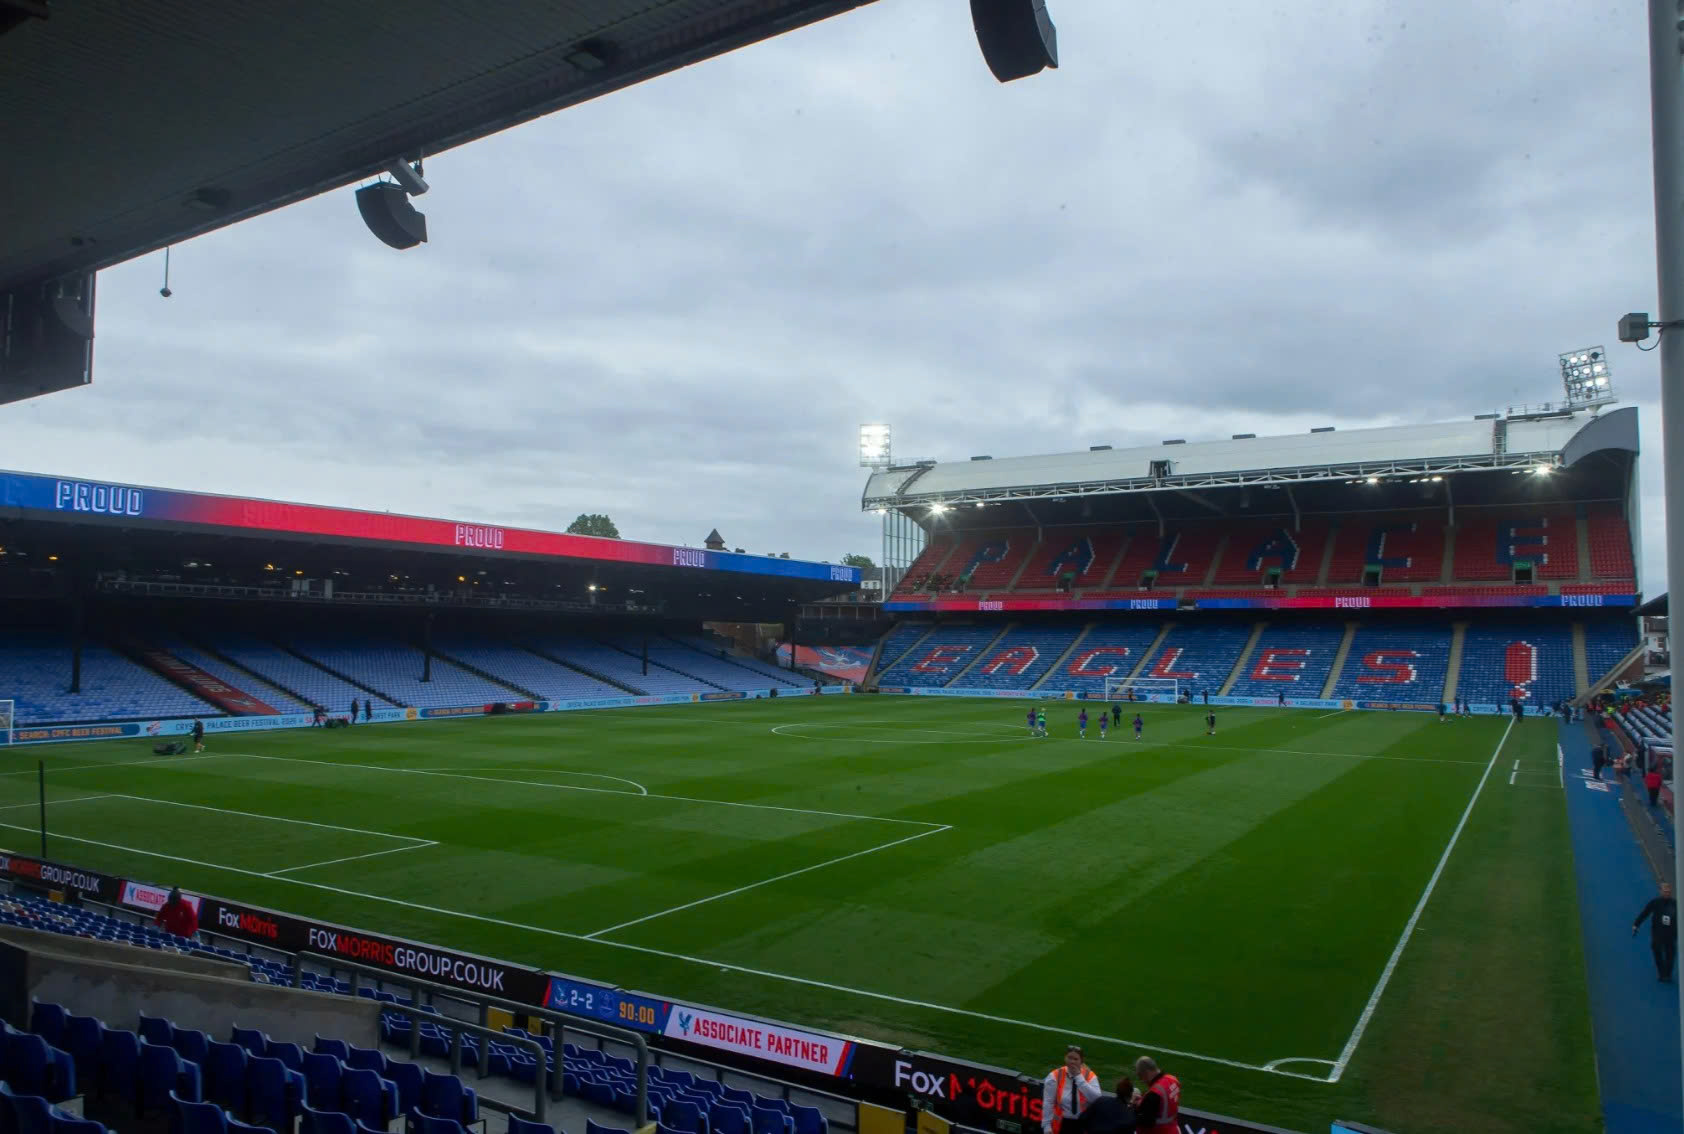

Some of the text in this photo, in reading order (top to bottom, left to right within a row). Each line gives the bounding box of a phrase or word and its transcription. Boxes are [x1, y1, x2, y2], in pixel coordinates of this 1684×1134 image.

[56, 480, 143, 516] PROUD
[455, 524, 505, 550] PROUD
[673, 547, 705, 568] PROUD
[830, 565, 853, 582] PROUD
[979, 600, 1003, 611] PROUD
[1130, 599, 1158, 610] PROUD
[1335, 595, 1370, 608] PROUD
[1561, 594, 1602, 607] PROUD
[206, 720, 232, 729] PALACE
[233, 719, 250, 728] BEER
[251, 718, 280, 727] FESTIVAL
[309, 928, 504, 992] FOXMORRISGROUP.CO.UK
[570, 989, 593, 1010] 2-2
[619, 1001, 655, 1025] 90:00
[693, 1017, 829, 1065] ASSOCIATE PARTNER
